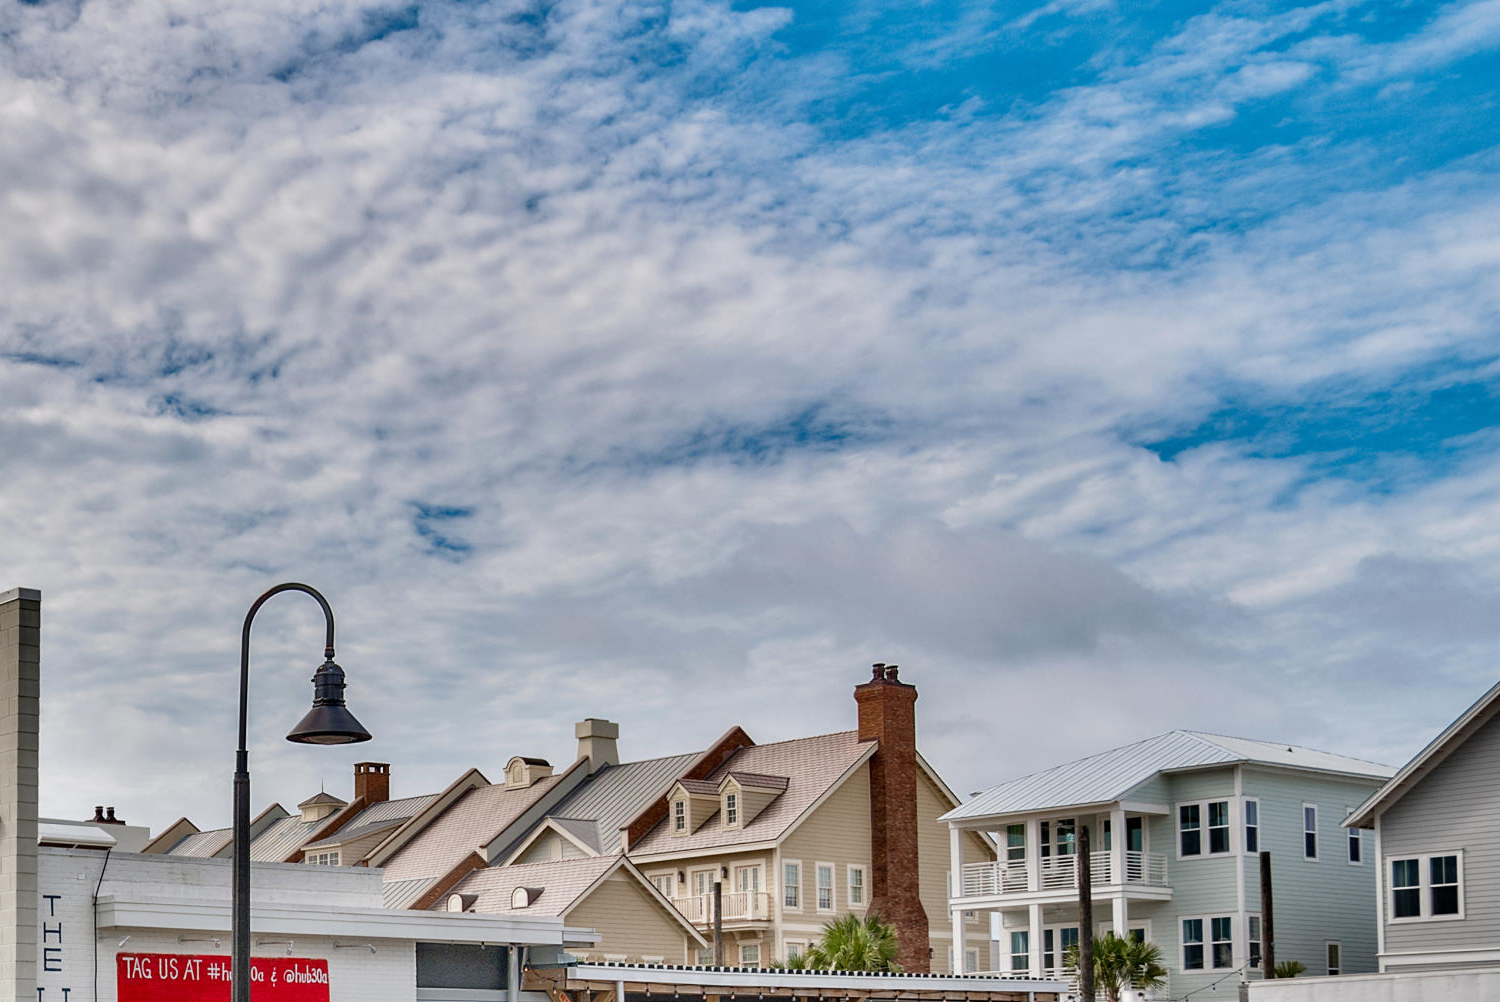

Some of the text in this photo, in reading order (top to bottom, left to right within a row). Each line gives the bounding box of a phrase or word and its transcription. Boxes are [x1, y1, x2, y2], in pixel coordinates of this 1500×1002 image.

[42, 895, 62, 972] THE
[122, 956, 152, 979] TAG
[158, 957, 179, 980] US
[182, 959, 203, 981] AT
[283, 963, 329, 985] @hub30a
